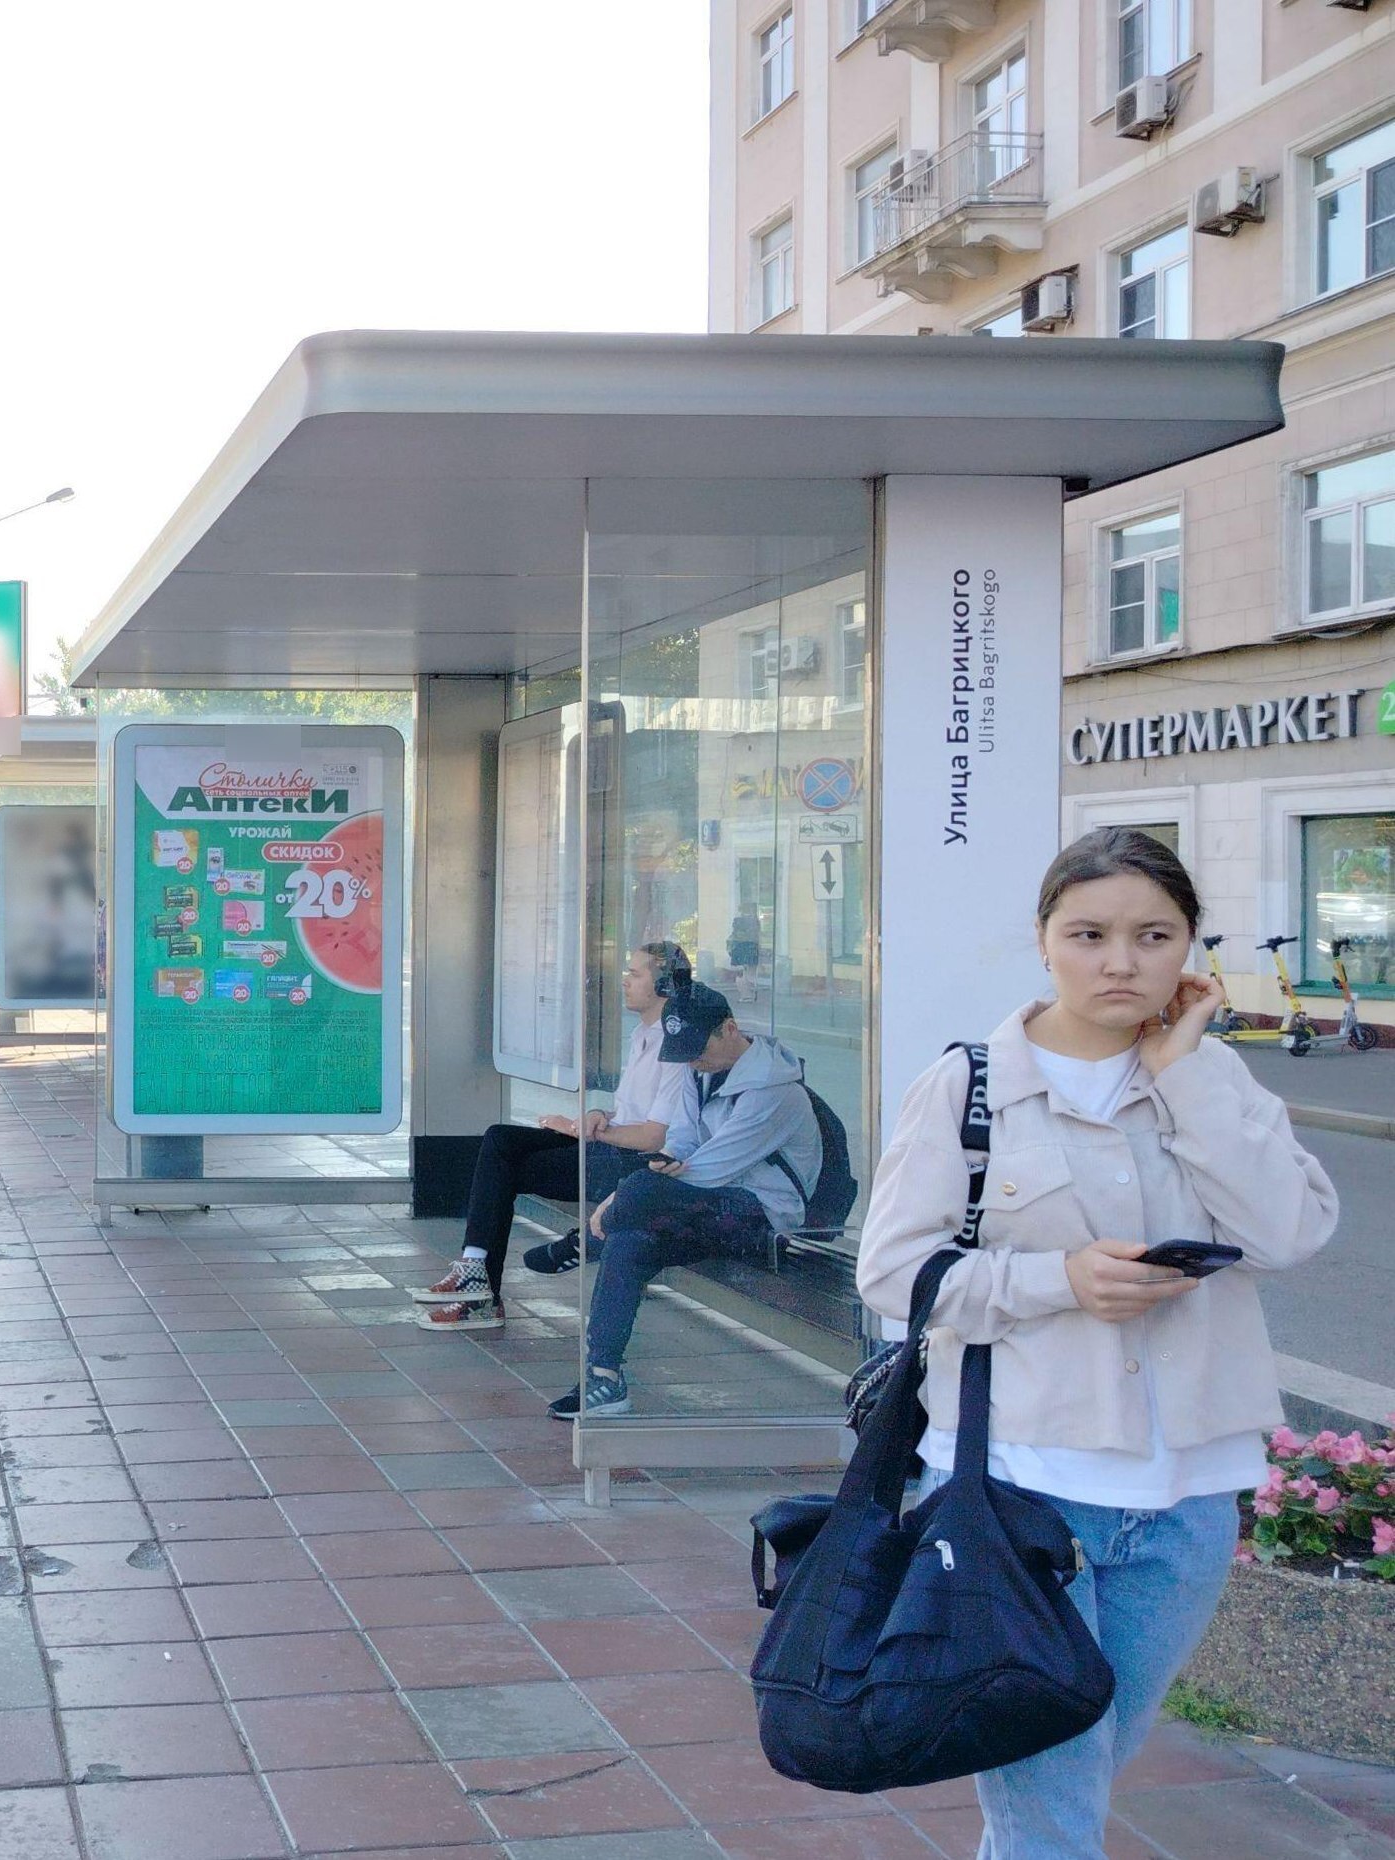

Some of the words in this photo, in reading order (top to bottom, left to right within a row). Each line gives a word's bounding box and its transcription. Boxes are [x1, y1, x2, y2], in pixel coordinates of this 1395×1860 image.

[979, 568, 1001, 689] Bagritskogo
[946, 568, 975, 744] Багрицкого
[979, 696, 996, 754] Ulitsa
[1066, 687, 1366, 766] СУПЕРМАРКЕТ
[198, 762, 319, 789] Столички
[943, 755, 972, 846] Улица
[228, 825, 292, 839] УРОЖАЙ
[269, 844, 335, 860] СКИДОК
[215, 882, 228, 891] 20
[275, 893, 293, 904] от
[262, 954, 275, 963] 20
[234, 989, 247, 998] 20
[291, 991, 305, 1001] 20
[968, 1047, 992, 1127] PRAD
